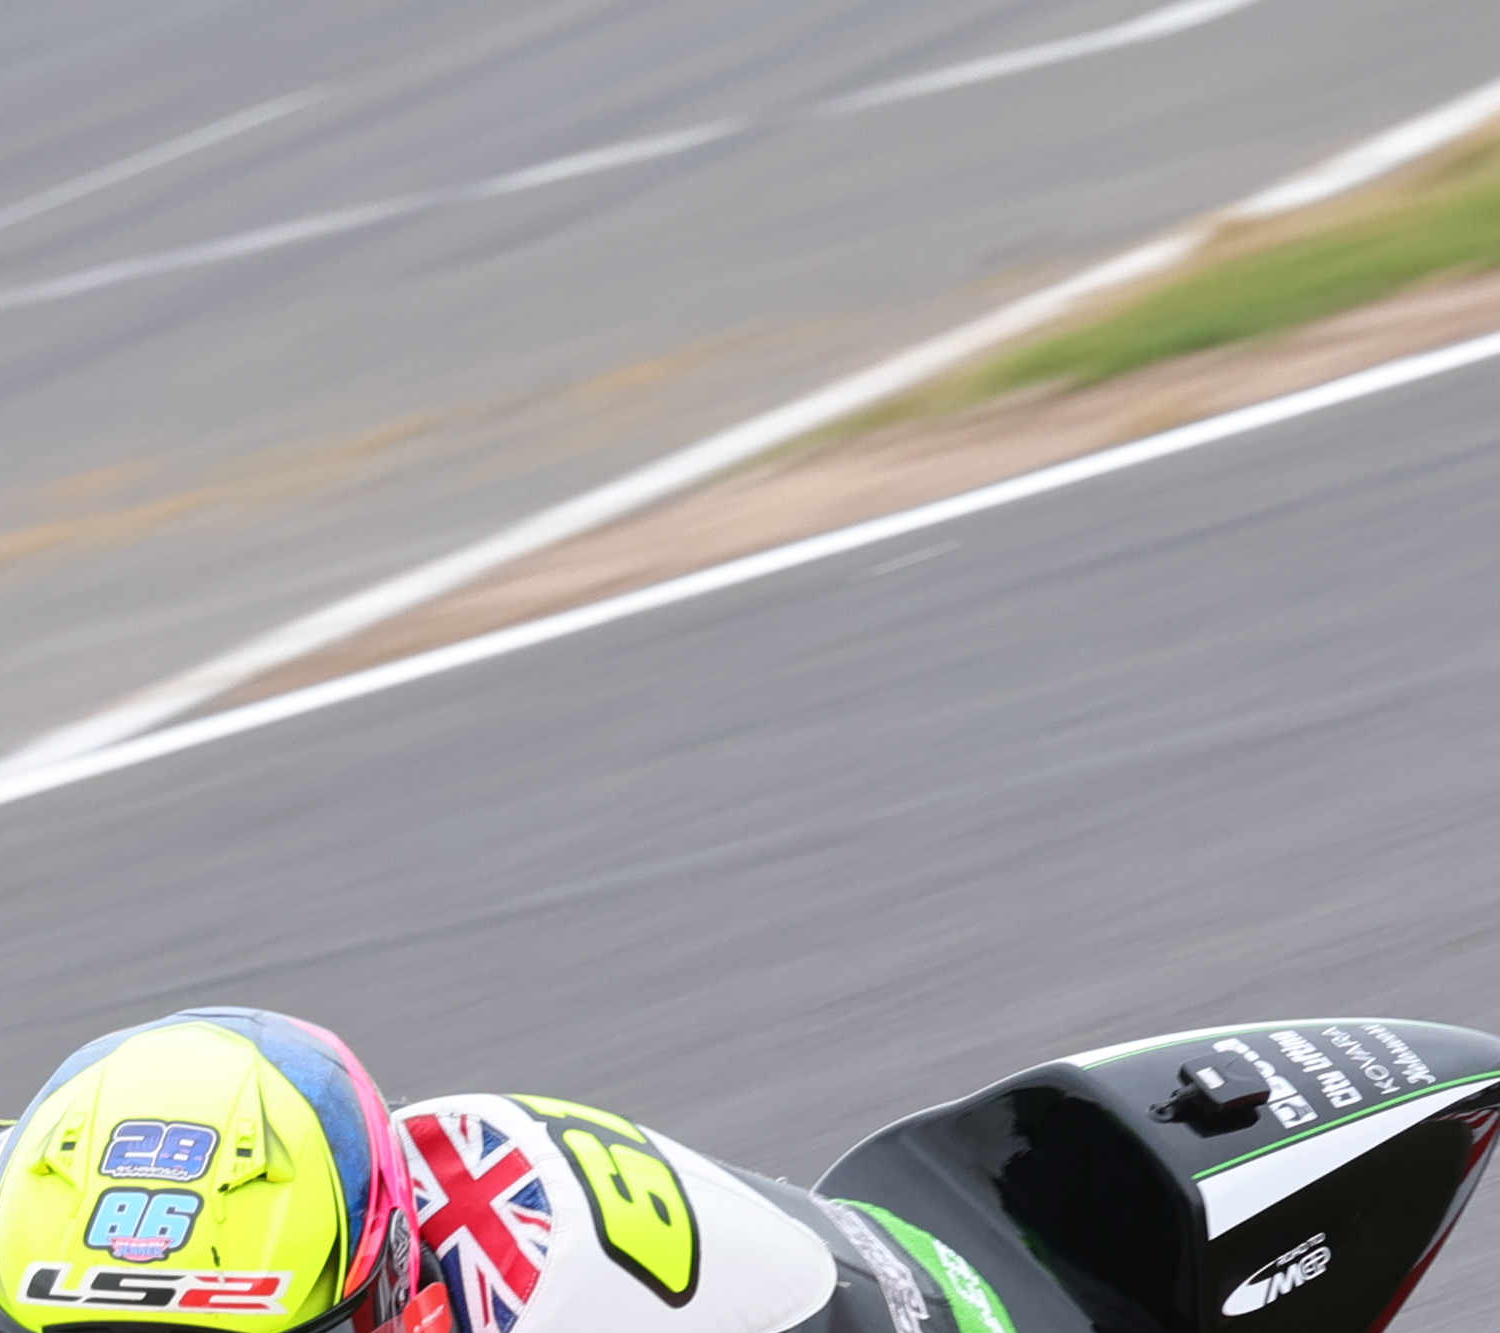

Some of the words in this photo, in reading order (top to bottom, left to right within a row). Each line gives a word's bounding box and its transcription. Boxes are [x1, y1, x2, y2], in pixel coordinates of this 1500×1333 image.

[102, 1121, 218, 1178] 28
[86, 1190, 201, 1251] 86
[25, 1267, 281, 1310] LS2
